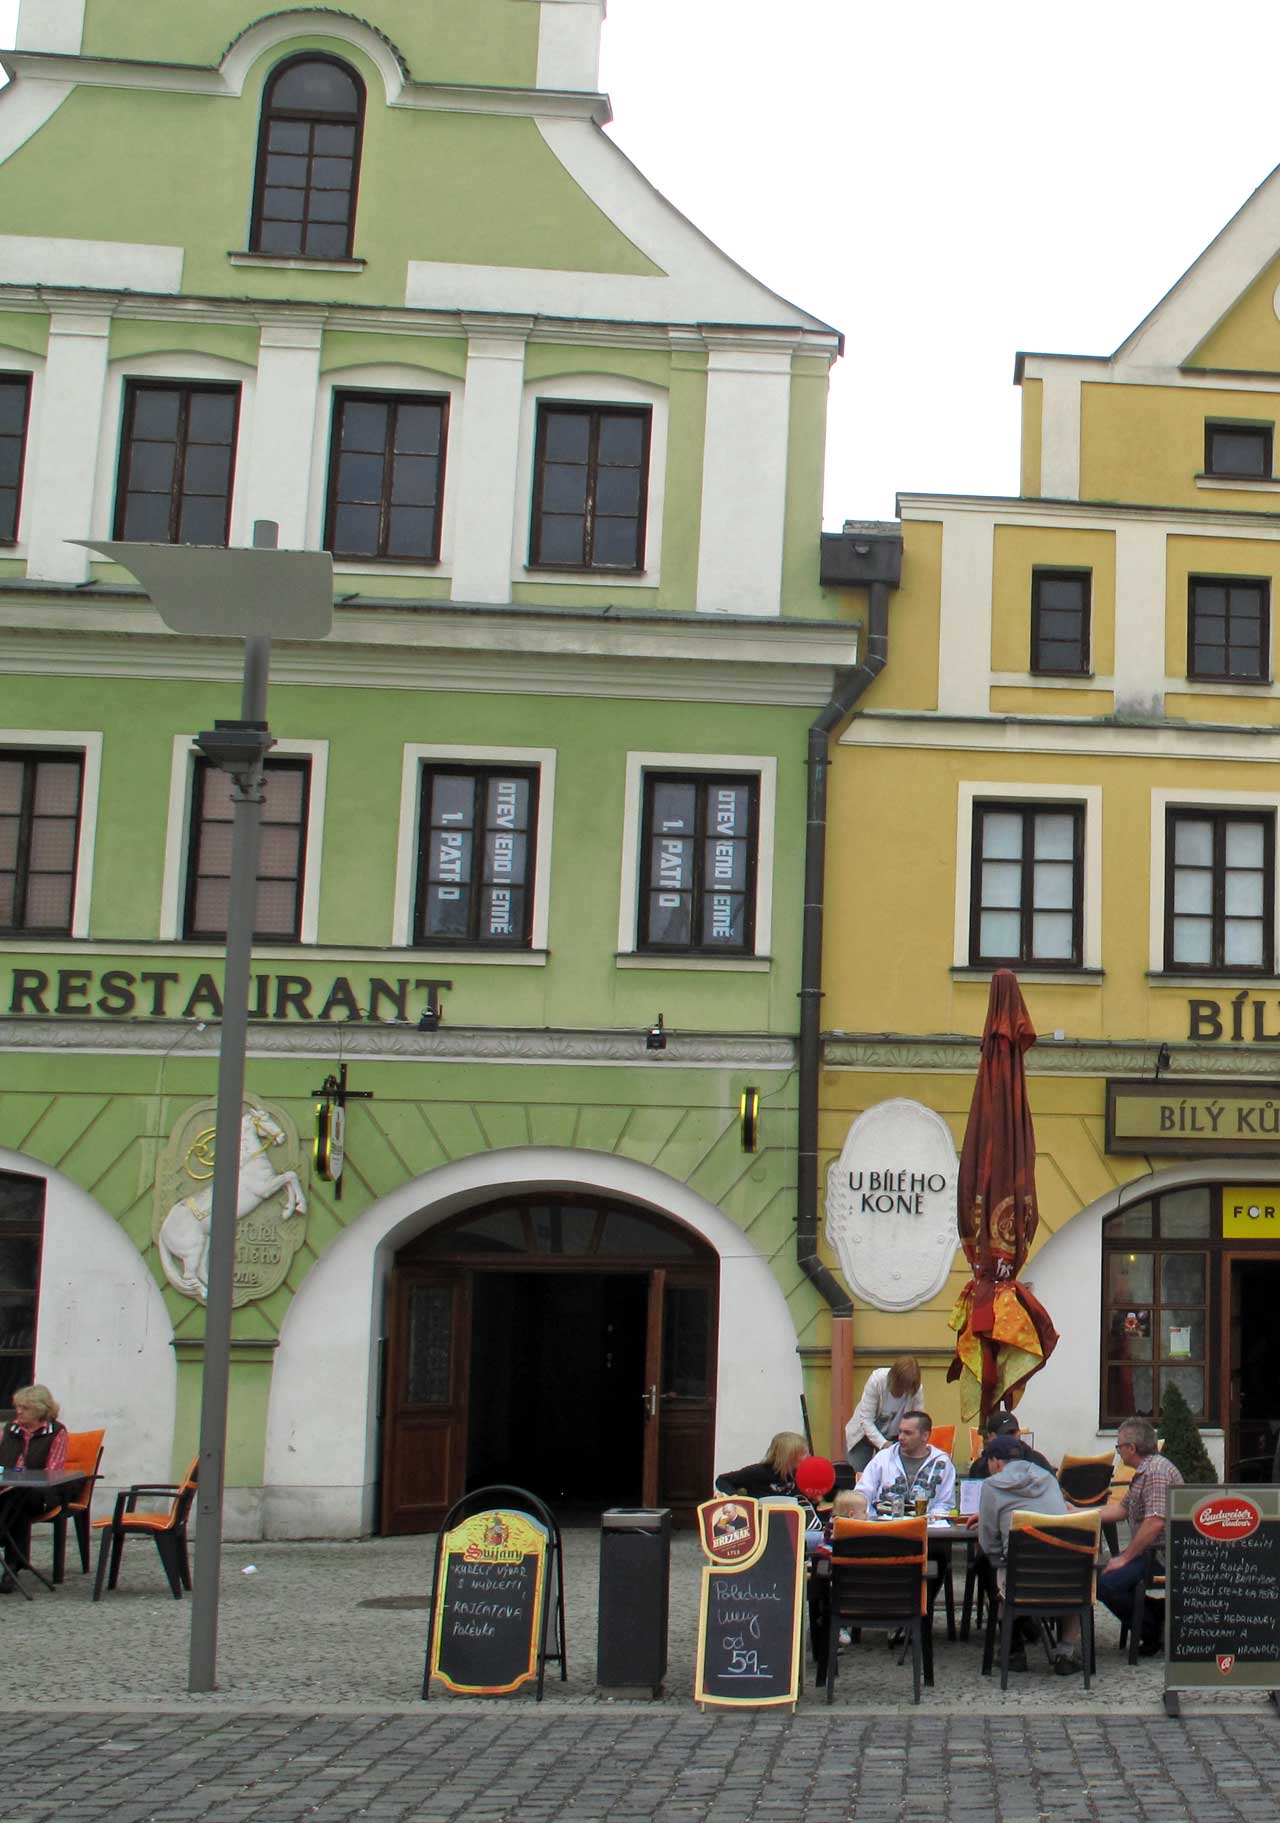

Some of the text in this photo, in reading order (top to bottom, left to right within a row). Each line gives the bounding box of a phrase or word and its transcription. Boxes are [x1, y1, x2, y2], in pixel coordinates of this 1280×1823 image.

[441, 811, 463, 824] 1.
[662, 819, 684, 832] 1.
[1159, 1101, 1229, 1132] BÍLÝ
[848, 1168, 946, 1193] U BÍLÉHO
[1200, 1508, 1254, 1526] Budweiser
[722, 1636, 745, 1650] od
